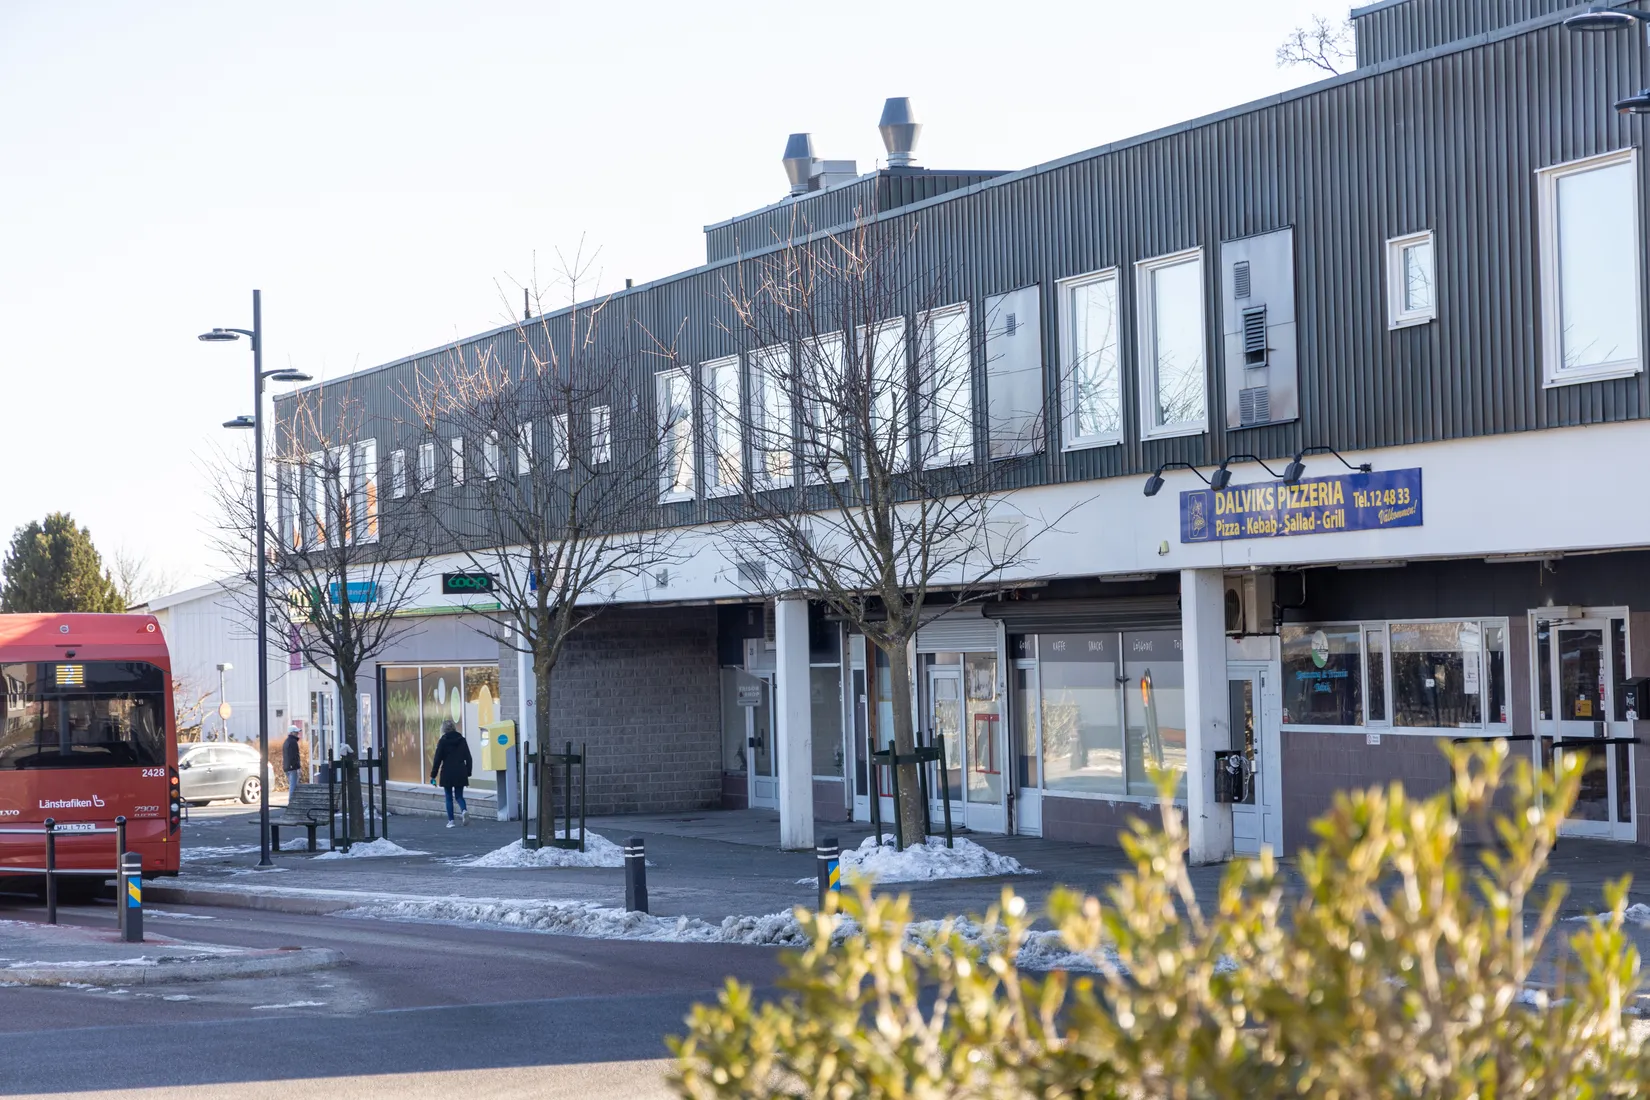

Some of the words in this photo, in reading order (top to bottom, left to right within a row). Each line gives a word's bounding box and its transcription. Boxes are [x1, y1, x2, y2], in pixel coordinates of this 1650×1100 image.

[1215, 487, 1275, 515] DALVIKS
[1277, 481, 1345, 510] PIZZERIA
[1383, 489, 1396, 505] 48
[1397, 487, 1410, 504] 33
[1378, 499, 1418, 524] Välkommen!
[1216, 519, 1240, 537] Pizza
[1247, 515, 1277, 535] Kebab
[1284, 511, 1315, 532] Sallad
[1322, 508, 1345, 529] Grill
[447, 576, 488, 590] coop
[1053, 641, 1066, 651] KAFFE
[1088, 641, 1104, 651] SNACKS
[142, 768, 165, 778] 2428
[39, 799, 92, 809] Länstrafiken
[134, 805, 159, 813] 7900
